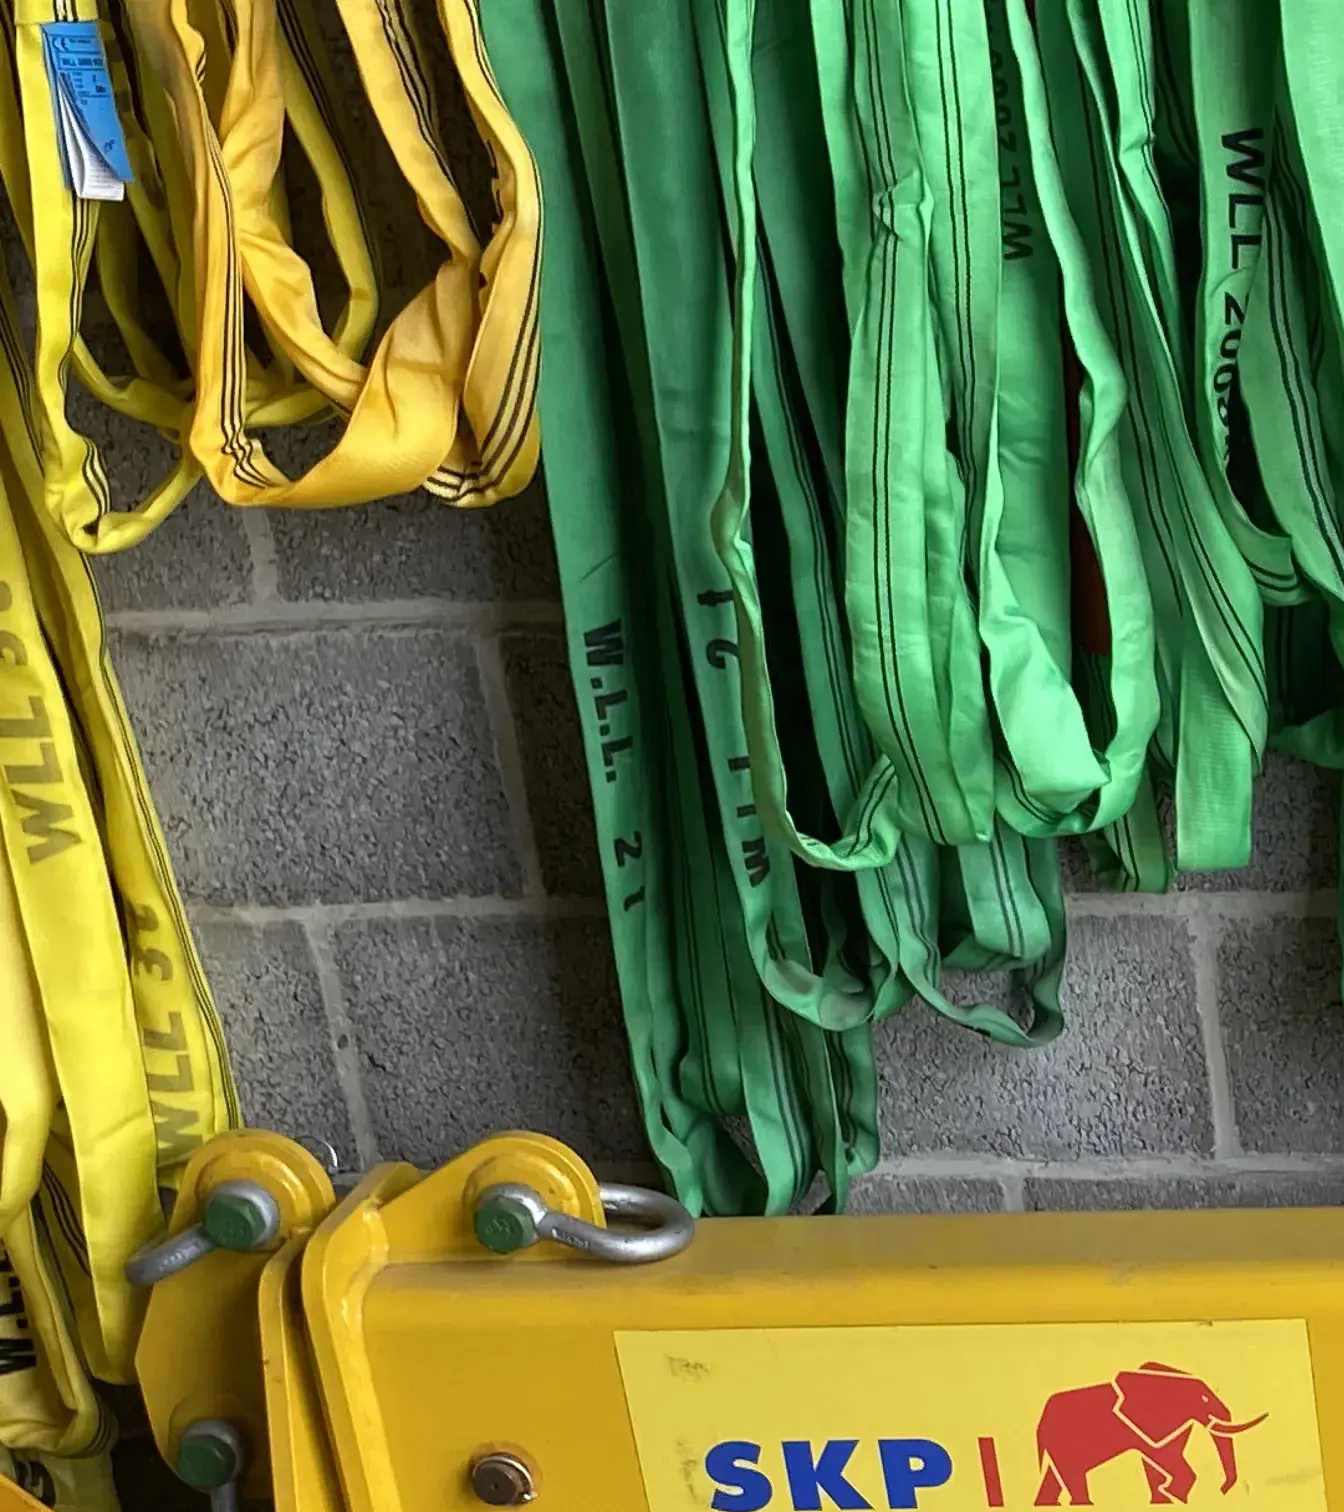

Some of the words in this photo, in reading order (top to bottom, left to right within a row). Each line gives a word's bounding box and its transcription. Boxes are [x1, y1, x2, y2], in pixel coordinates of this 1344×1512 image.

[1221, 128, 1267, 270] WLL
[0, 695, 82, 864] WLL
[584, 618, 634, 783] W.L.L.
